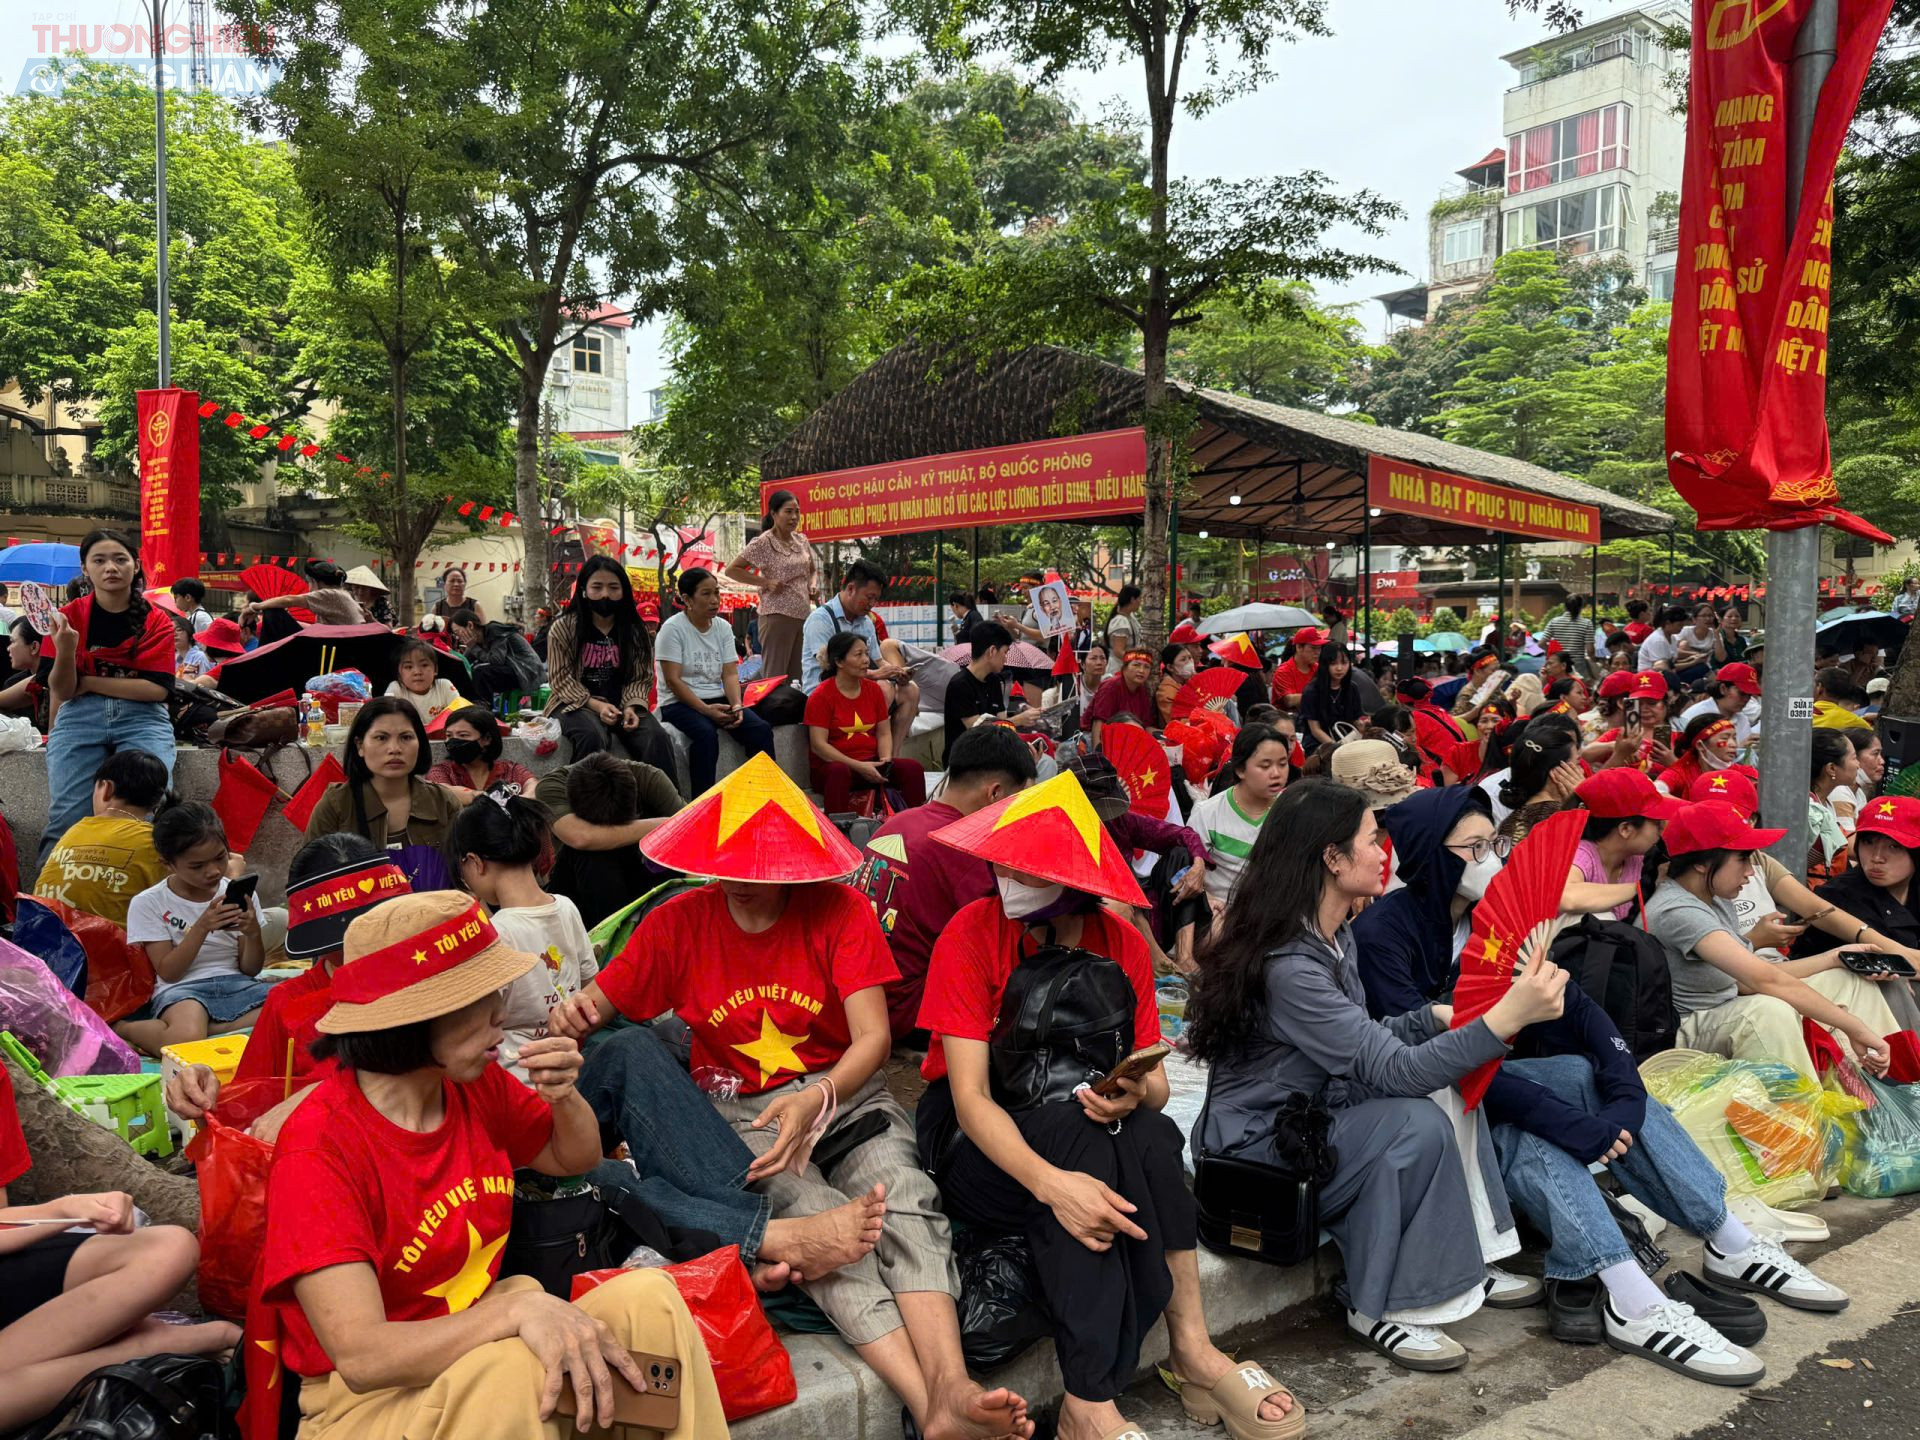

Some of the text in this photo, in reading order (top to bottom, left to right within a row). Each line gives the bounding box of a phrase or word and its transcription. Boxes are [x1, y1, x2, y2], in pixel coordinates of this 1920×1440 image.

[1714, 94, 1774, 131] MẠNG
[1721, 134, 1767, 169] TÁM
[1737, 257, 1768, 294] SỬ
[808, 481, 837, 503] TỔNG
[838, 482, 861, 501] CỤC
[863, 476, 885, 498] HẬU
[888, 470, 912, 491] CẦN
[921, 469, 935, 487] KỸ
[937, 464, 976, 486] THUẬT,
[979, 461, 997, 483] BỘ
[1000, 454, 1040, 478] QUỐC
[1043, 451, 1093, 473] PHÒNG
[806, 511, 824, 532] PHÁT
[825, 508, 849, 529] LƯƠNG
[850, 502, 865, 527] KHÔ
[867, 503, 887, 528] PHỤC
[888, 501, 900, 526] VỤ
[900, 495, 923, 521] NHÂN
[925, 492, 942, 517] DÂN
[943, 487, 955, 516] CỔ
[970, 487, 988, 514] CÁC
[989, 487, 1007, 516] LỰC
[1009, 484, 1040, 513] LƯỢNG
[1389, 471, 1590, 535] NHÀ BẠT PHỤC VỤ NHÂN DÂN
[316, 893, 333, 909] TÔI
[333, 887, 356, 903] YÊU
[379, 872, 399, 889] VIỆT
[434, 920, 481, 955] TÔI YÊU
[708, 983, 824, 1028] TÔI YÊU VIỆT NAM
[393, 1236, 428, 1273] TÔI
[417, 1199, 448, 1238] YÊU
